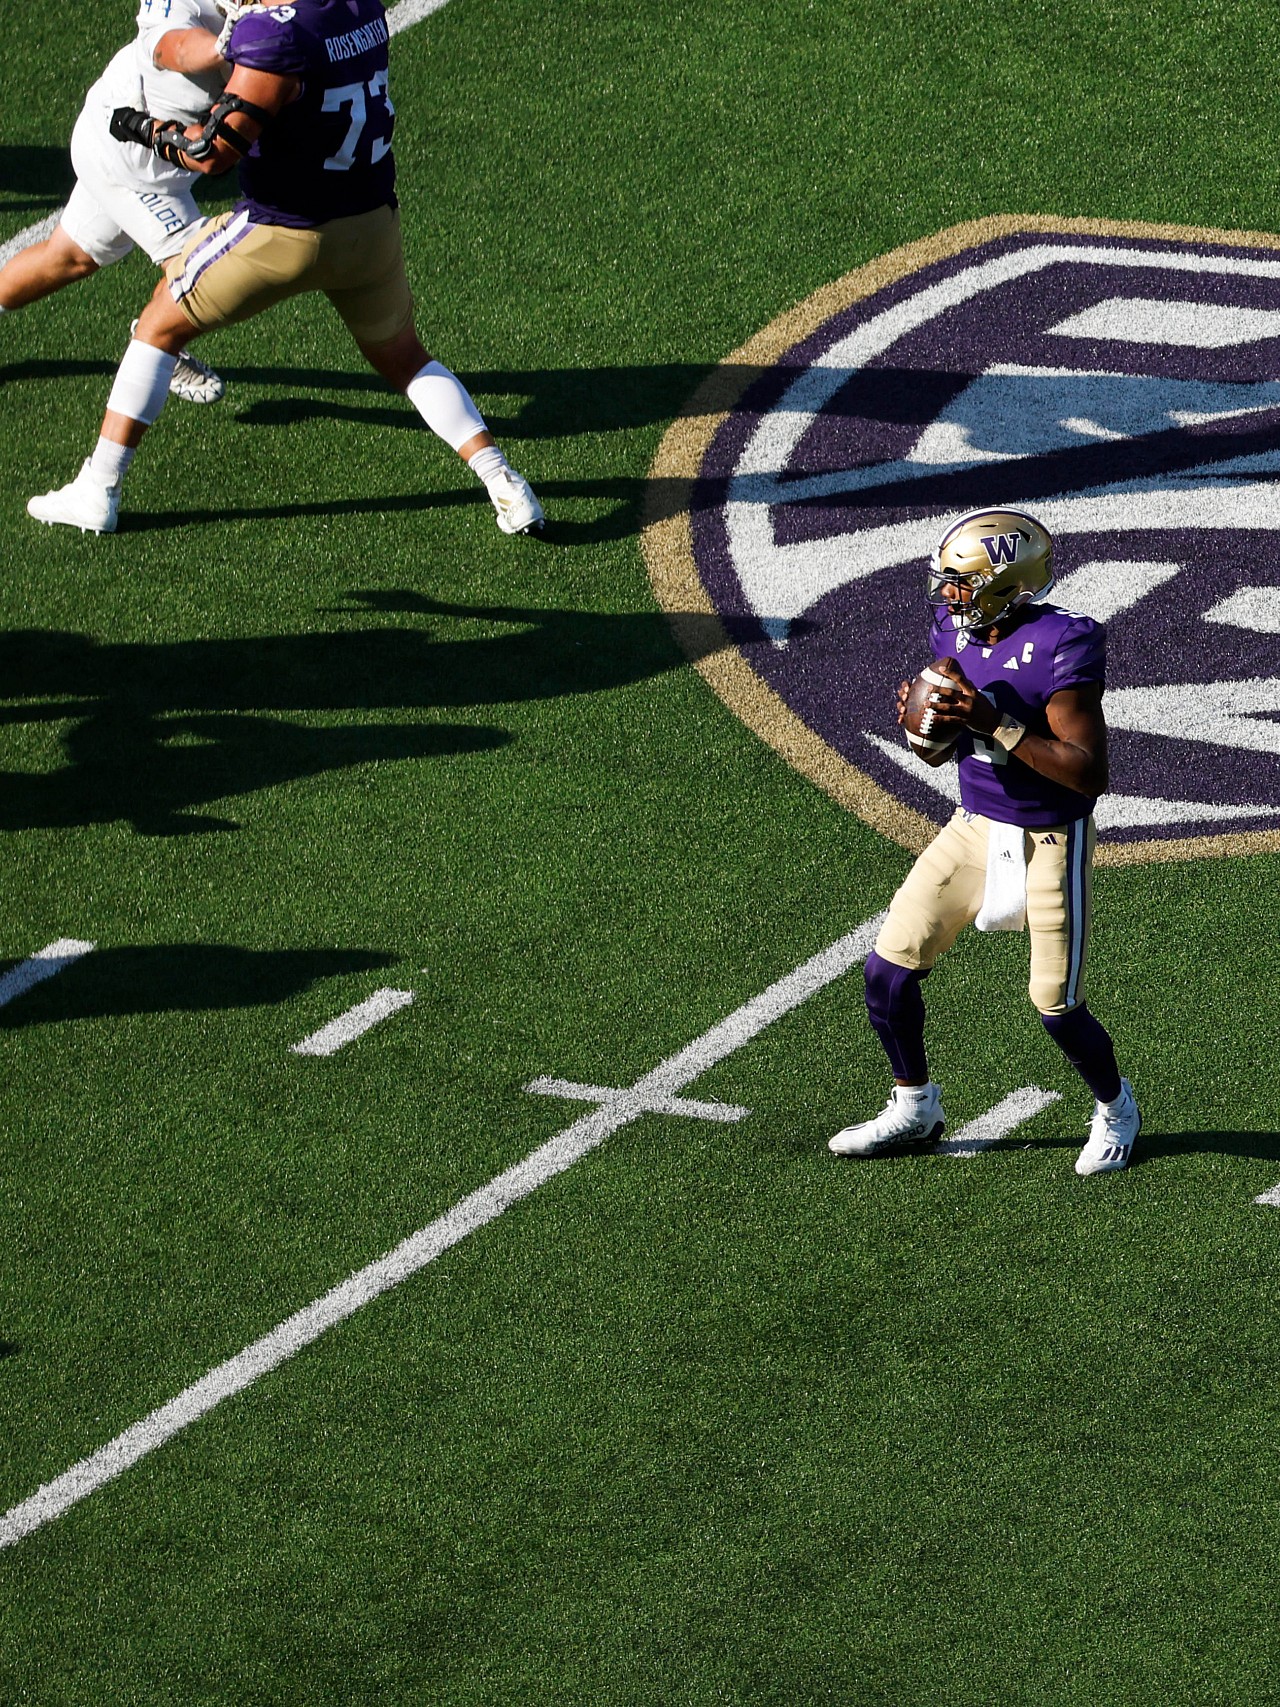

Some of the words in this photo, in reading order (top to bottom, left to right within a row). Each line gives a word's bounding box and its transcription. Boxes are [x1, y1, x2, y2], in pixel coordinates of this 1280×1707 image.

[325, 17, 388, 63] ROSENGARTEN
[321, 67, 395, 171] 73
[135, 191, 185, 237] OLDE
[980, 532, 1020, 566] W
[1021, 642, 1035, 664] C
